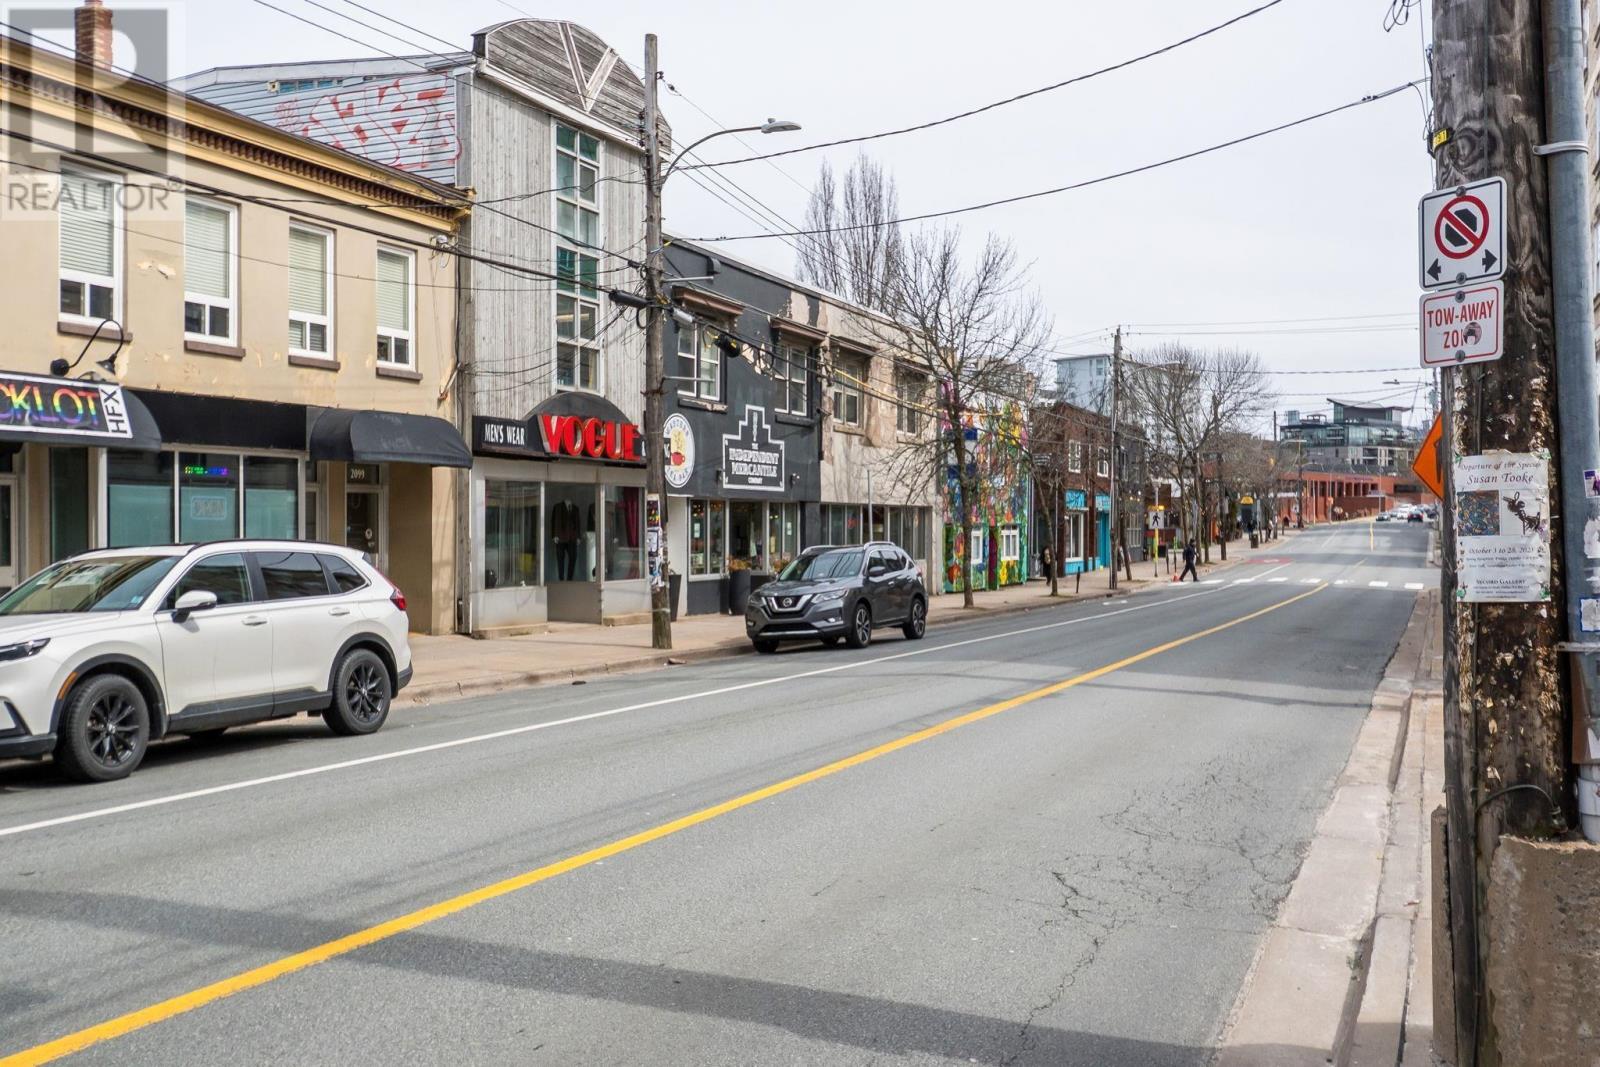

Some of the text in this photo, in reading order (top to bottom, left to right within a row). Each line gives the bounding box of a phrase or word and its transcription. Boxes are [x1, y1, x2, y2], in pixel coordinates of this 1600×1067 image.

[1427, 300, 1495, 328] TOW-AWAY
[1443, 328, 1470, 350] ZO
[101, 389, 127, 434] HFX
[484, 423, 525, 446] MEN'S WEAR
[538, 411, 640, 461] VOGUE
[350, 468, 365, 480] 2099
[732, 462, 778, 477] MERCANTILE
[1467, 471, 1534, 485] Susan Tooke
